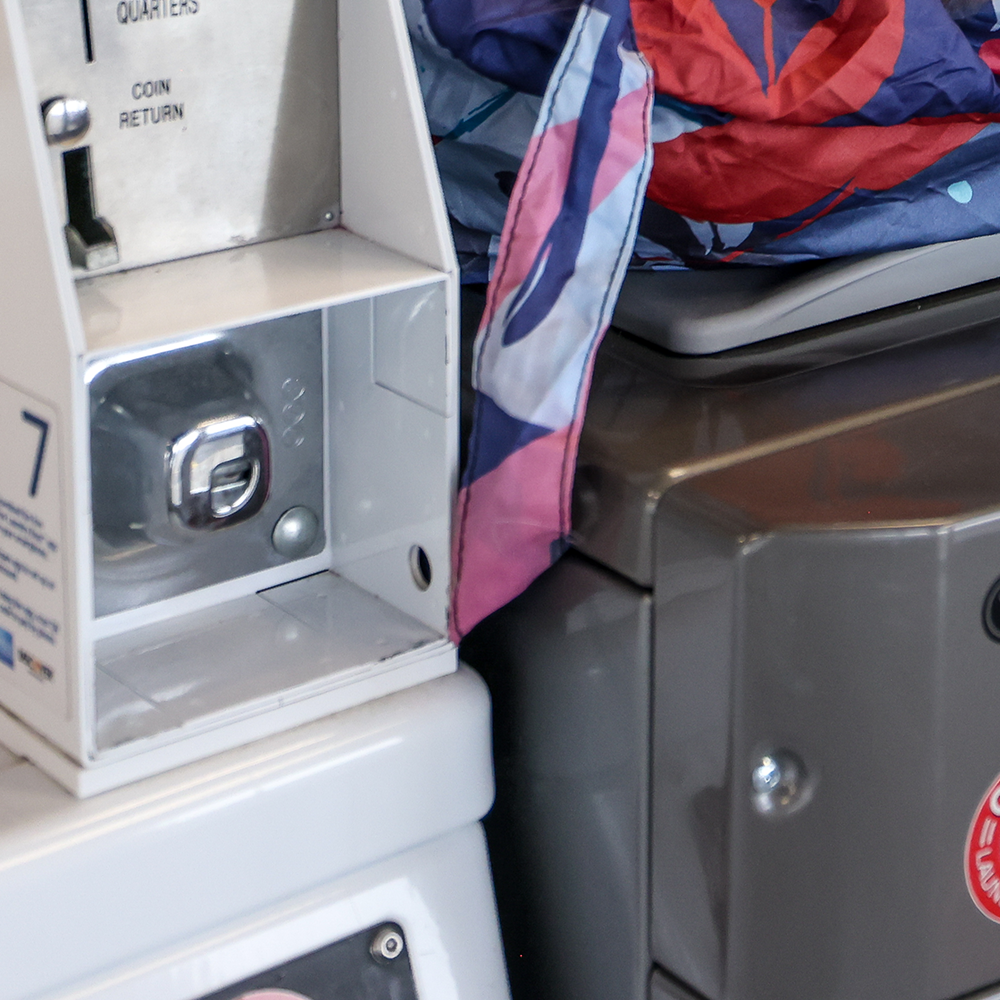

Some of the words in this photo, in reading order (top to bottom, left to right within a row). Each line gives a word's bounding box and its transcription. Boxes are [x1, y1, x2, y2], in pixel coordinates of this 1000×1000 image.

[131, 78, 171, 100] COIN
[119, 103, 185, 129] RETURN
[21, 410, 49, 498] 7
